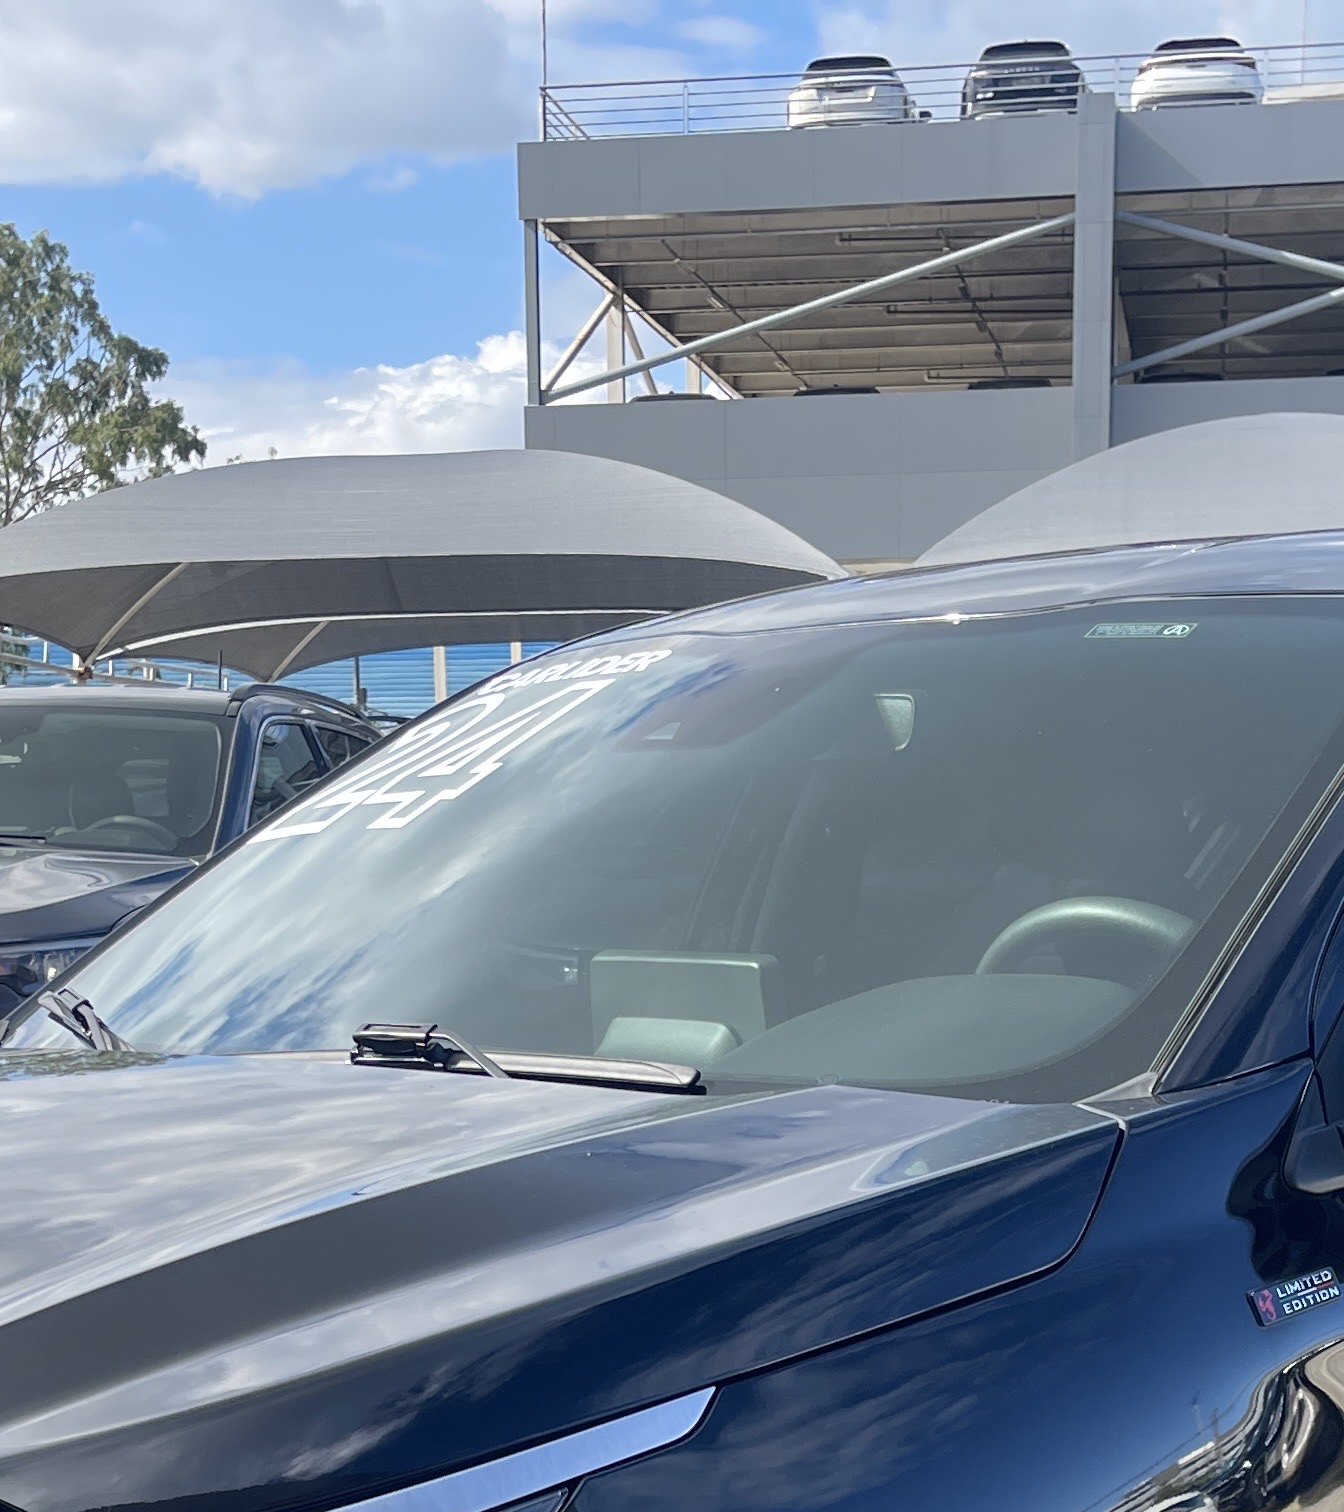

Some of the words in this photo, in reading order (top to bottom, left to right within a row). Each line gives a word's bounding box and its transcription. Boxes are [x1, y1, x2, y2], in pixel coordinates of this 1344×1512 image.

[479, 650, 673, 696] CARLIDER
[247, 678, 616, 845] 24
[1275, 1270, 1333, 1298] LIMITED
[1282, 1286, 1340, 1315] EDITION
